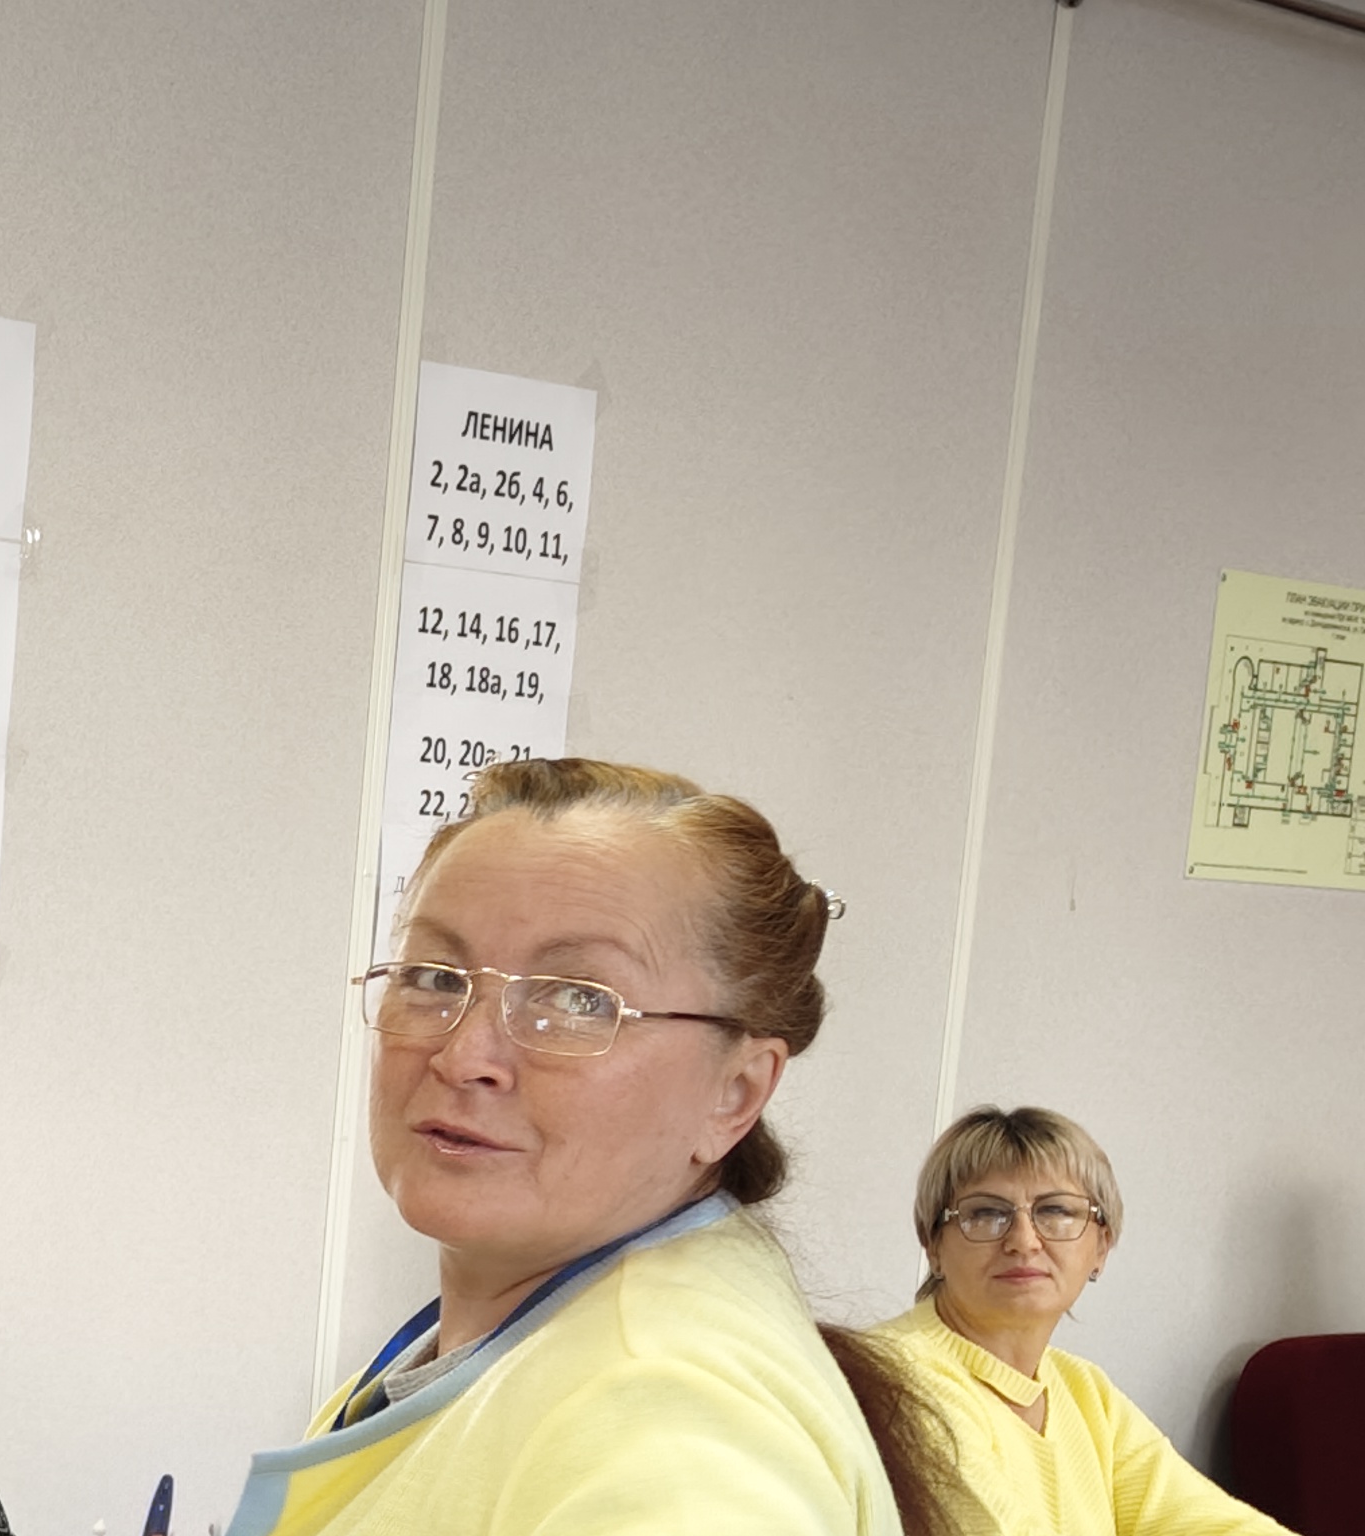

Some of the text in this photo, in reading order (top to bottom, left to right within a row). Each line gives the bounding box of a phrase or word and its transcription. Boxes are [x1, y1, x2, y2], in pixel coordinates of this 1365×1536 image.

[461, 410, 555, 452] ЛЕНИНА
[430, 460, 449, 495] 2,
[455, 464, 487, 500] 2а,
[532, 476, 550, 510] 4,
[556, 480, 574, 513] 6,
[427, 514, 568, 566] 7, 8, 9, 10, 11,
[418, 606, 449, 641] 12,
[457, 611, 488, 645] 14,
[495, 615, 520, 644] 16
[426, 661, 544, 704] 18, 18а, 19,
[420, 736, 452, 770] 20,
[419, 789, 451, 822] 22,
